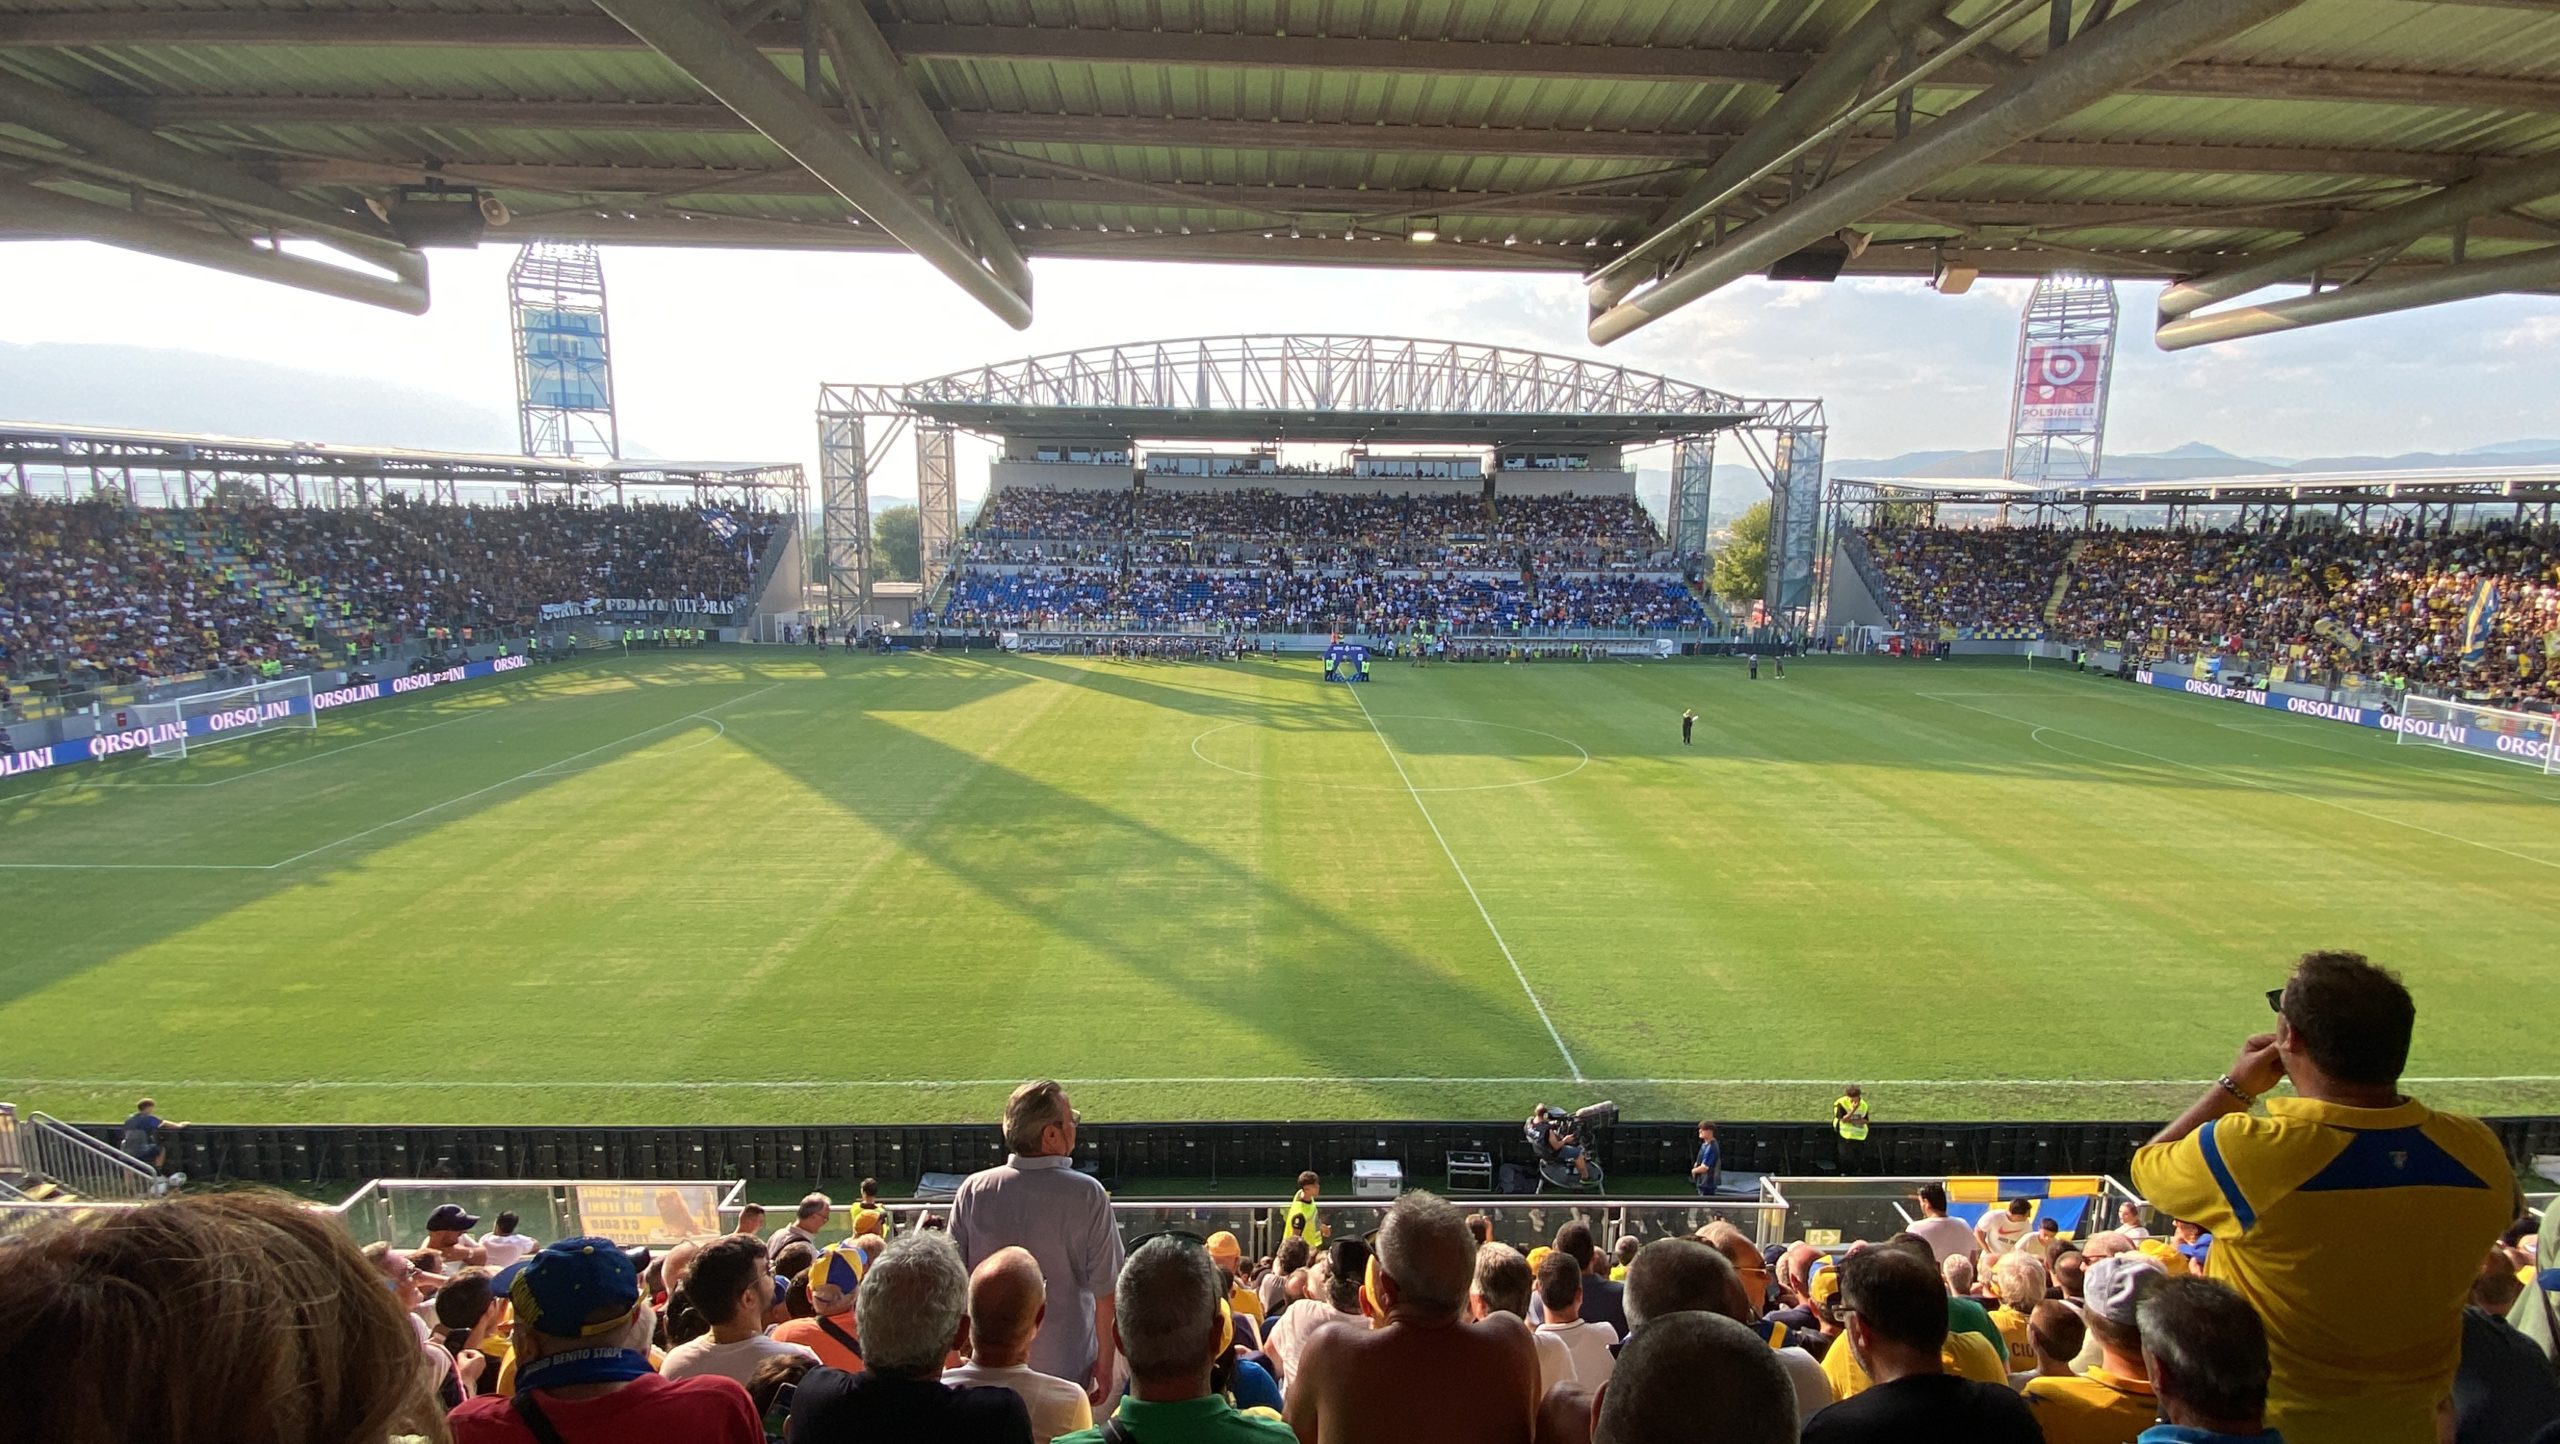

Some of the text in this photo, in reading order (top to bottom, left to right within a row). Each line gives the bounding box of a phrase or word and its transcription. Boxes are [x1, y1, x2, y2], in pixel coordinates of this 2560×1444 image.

[2022, 407, 2094, 417] POLSINELLI
[494, 655, 527, 672] ORSOL
[2136, 670, 2153, 685] INI
[314, 683, 380, 710] ORSOLINI
[210, 700, 291, 731] ORSOLINI
[2287, 697, 2361, 723] ORSOLINI
[2380, 713, 2467, 744] ORSOLINI
[553, 1348, 590, 1365] BENITO
